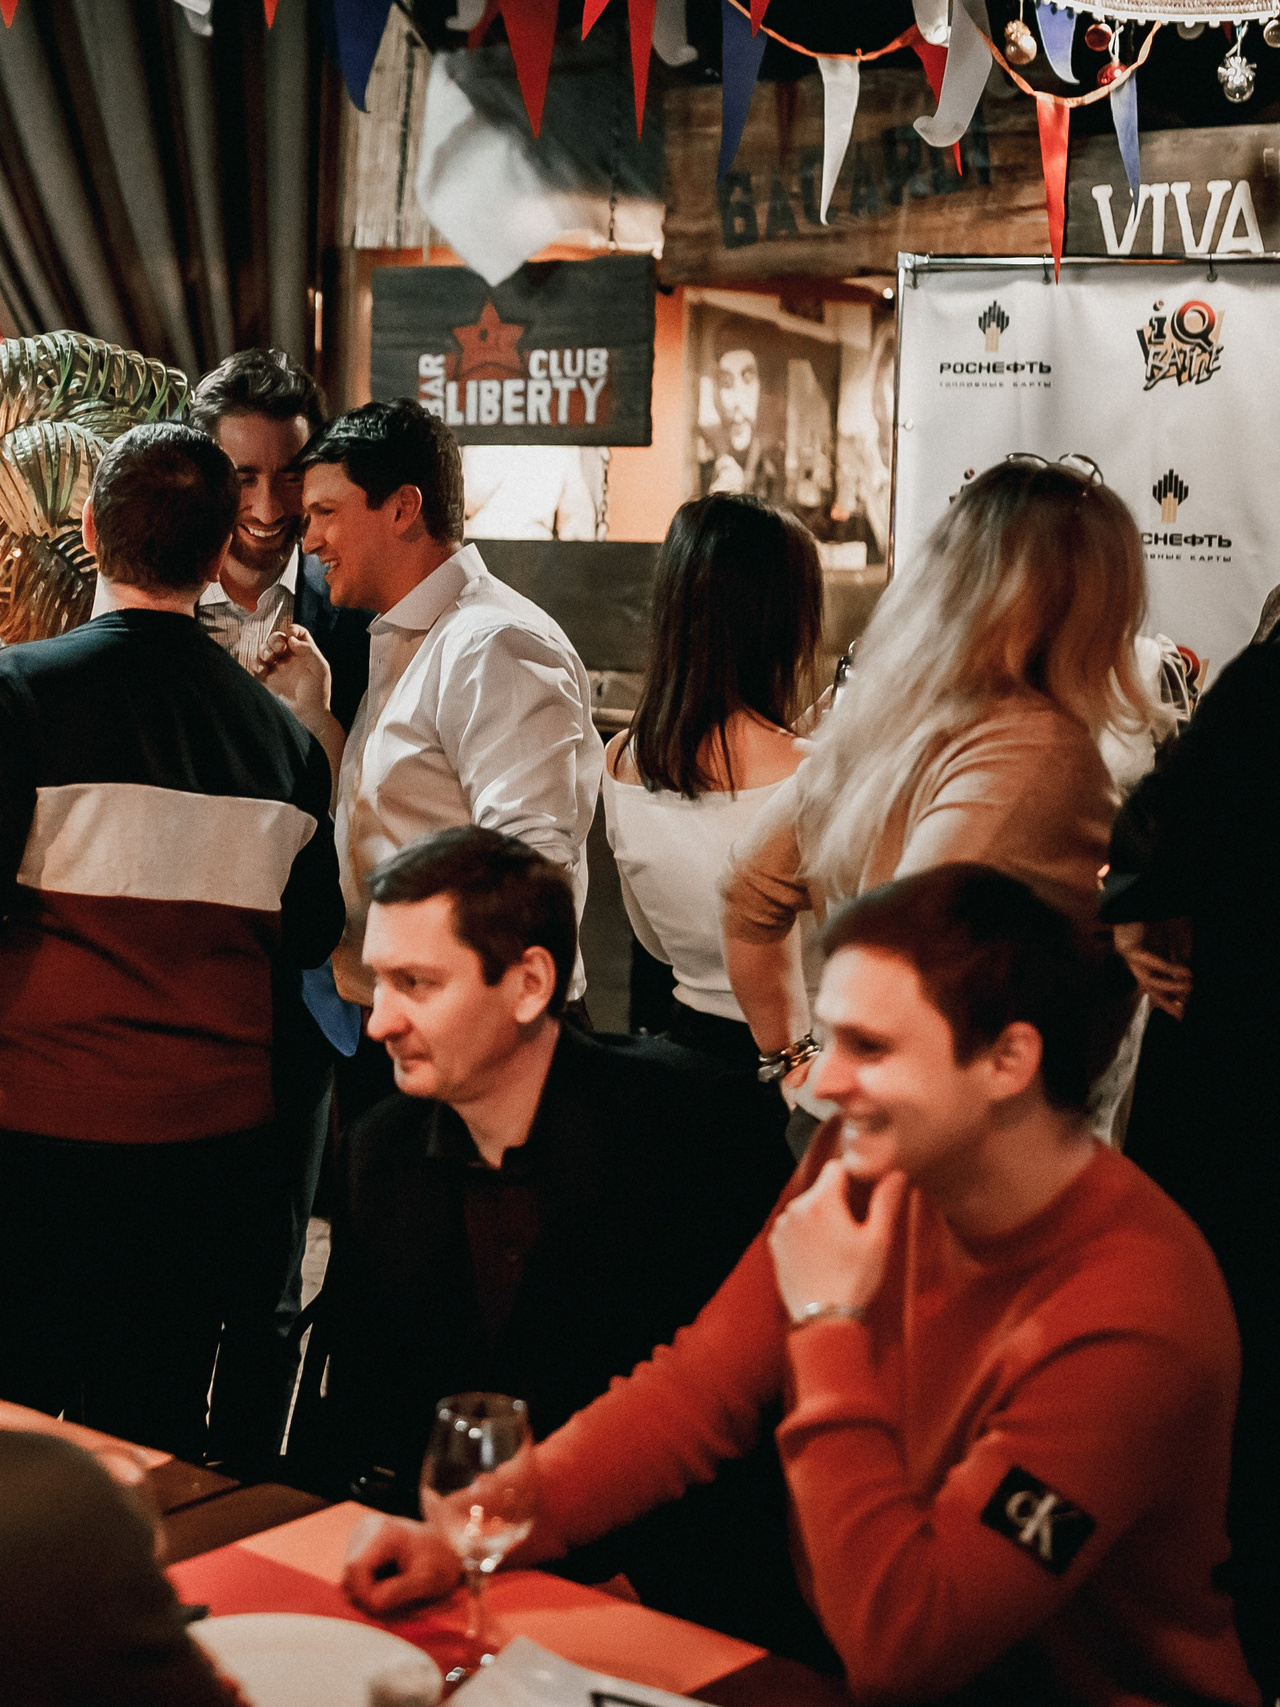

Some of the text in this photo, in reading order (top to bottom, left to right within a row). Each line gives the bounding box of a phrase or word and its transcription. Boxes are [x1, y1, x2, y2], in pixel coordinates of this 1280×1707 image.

[1091, 179, 1265, 255] VIVA
[528, 348, 609, 380] CLUB
[939, 361, 1052, 374] РОСНЕФТЬ
[445, 377, 606, 425] LIBERTY
[1141, 532, 1232, 548] СНЕФТЬ
